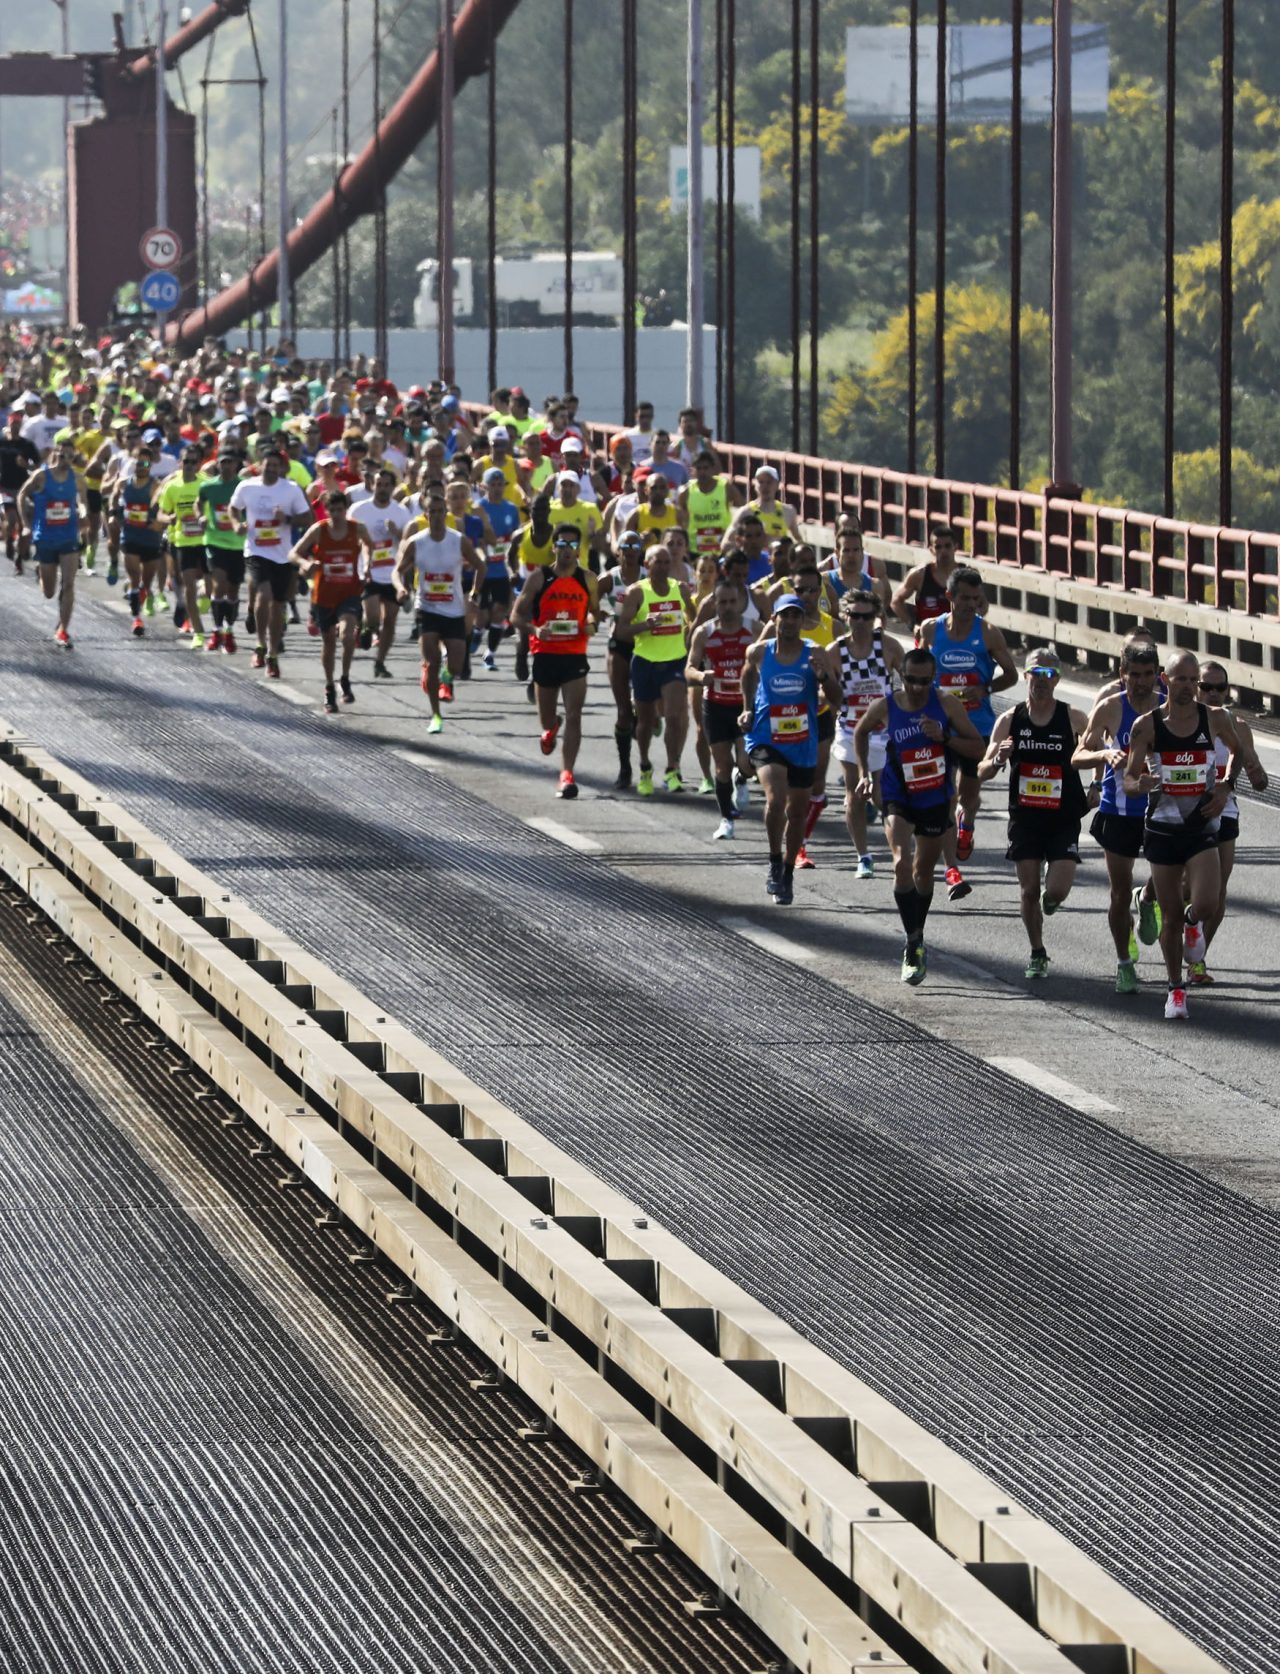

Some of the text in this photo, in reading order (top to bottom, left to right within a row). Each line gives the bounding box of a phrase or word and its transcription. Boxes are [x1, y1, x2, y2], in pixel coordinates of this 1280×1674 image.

[149, 240, 175, 257] 70
[146, 282, 177, 302] 40
[944, 654, 975, 663] Mimosa
[773, 678, 804, 687] Mimosa
[781, 704, 799, 717] edp
[1018, 739, 1063, 751] Alimco
[914, 747, 933, 760] edp
[1175, 752, 1194, 766] edp
[1031, 766, 1050, 779] edp
[1175, 772, 1191, 781] 241
